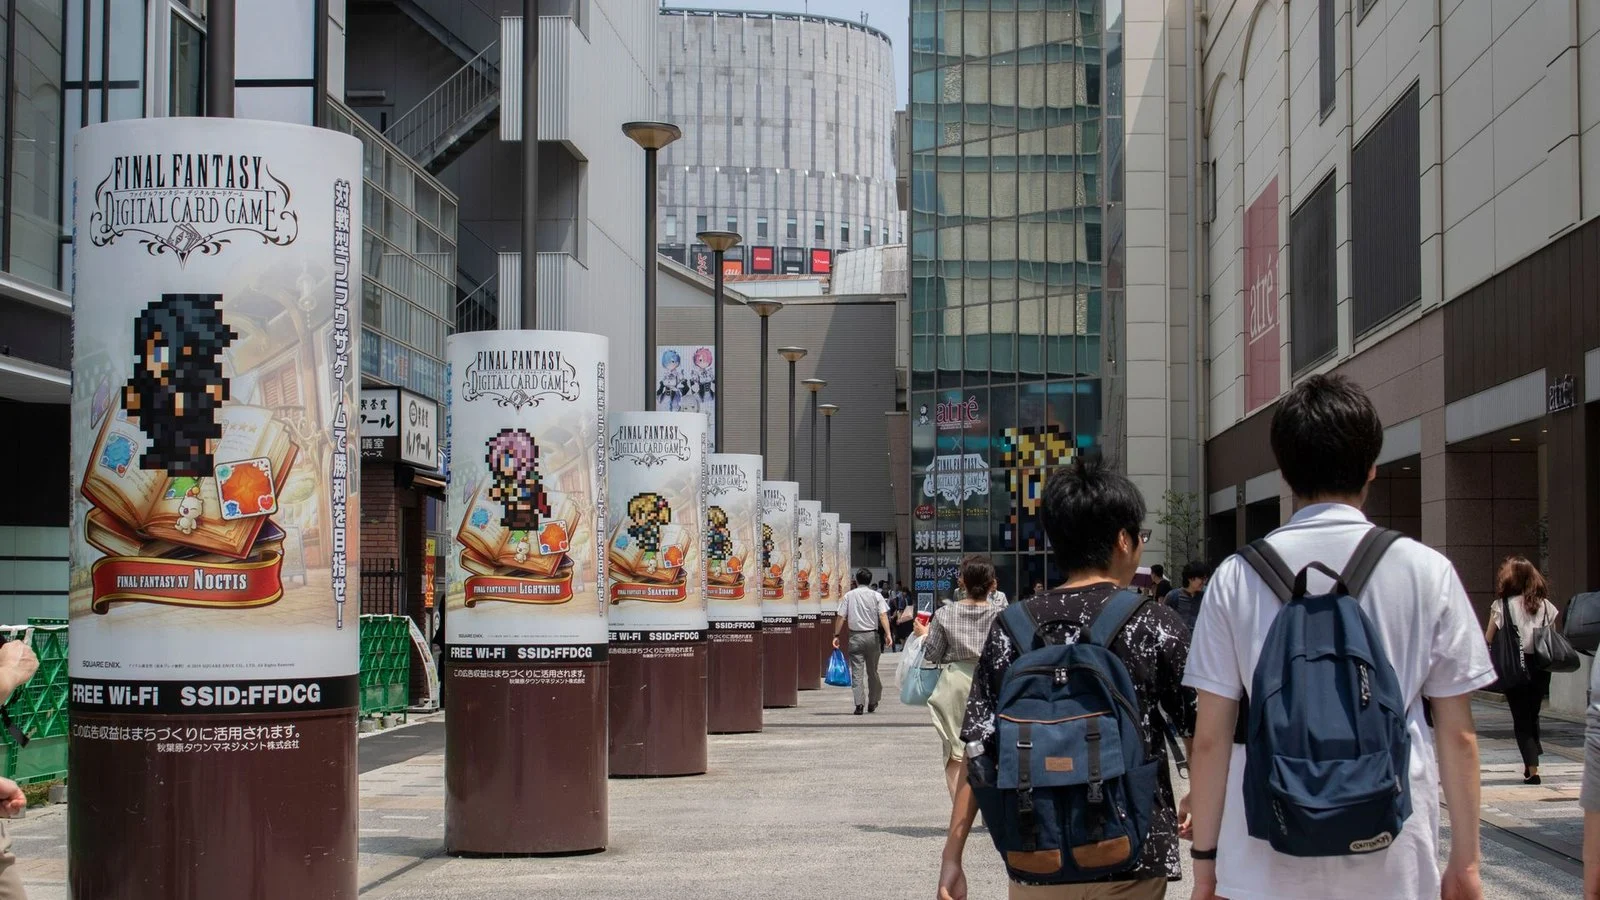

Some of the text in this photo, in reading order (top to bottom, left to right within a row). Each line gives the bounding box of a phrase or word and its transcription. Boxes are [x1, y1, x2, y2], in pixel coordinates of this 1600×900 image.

[114, 154, 263, 190] FINAL FANTASY
[104, 190, 278, 233] DIGITAL CARD GAME
[1250, 253, 1273, 338] atré
[477, 351, 561, 371] FINAL FANTASY
[471, 370, 570, 394] DIGITAL CARD GAME
[936, 394, 979, 423] atré
[619, 425, 679, 440] FINAL FANTASY
[406, 429, 432, 460] ルノアール
[614, 439, 684, 456] DIGITAL CARD GAME
[915, 530, 961, 550] 対戦型
[117, 575, 138, 588] FINAL
[140, 575, 176, 588] FANTASY
[178, 576, 189, 588] XV
[715, 621, 755, 629] SSID:FFDCG
[619, 632, 641, 640] Wi-Fi
[649, 631, 699, 640] SSID:FFDCG
[450, 646, 593, 659] FREE Wi-Fi SSID:FFDCG
[82, 660, 104, 668] SQUARE
[72, 684, 321, 706] FREE Wi-Fi SSID:FFDCG
[73, 724, 301, 742] この広告収益はまちづくりに活用されます。
[157, 740, 300, 752] 秋葉原タウンマネジメント株式会社
